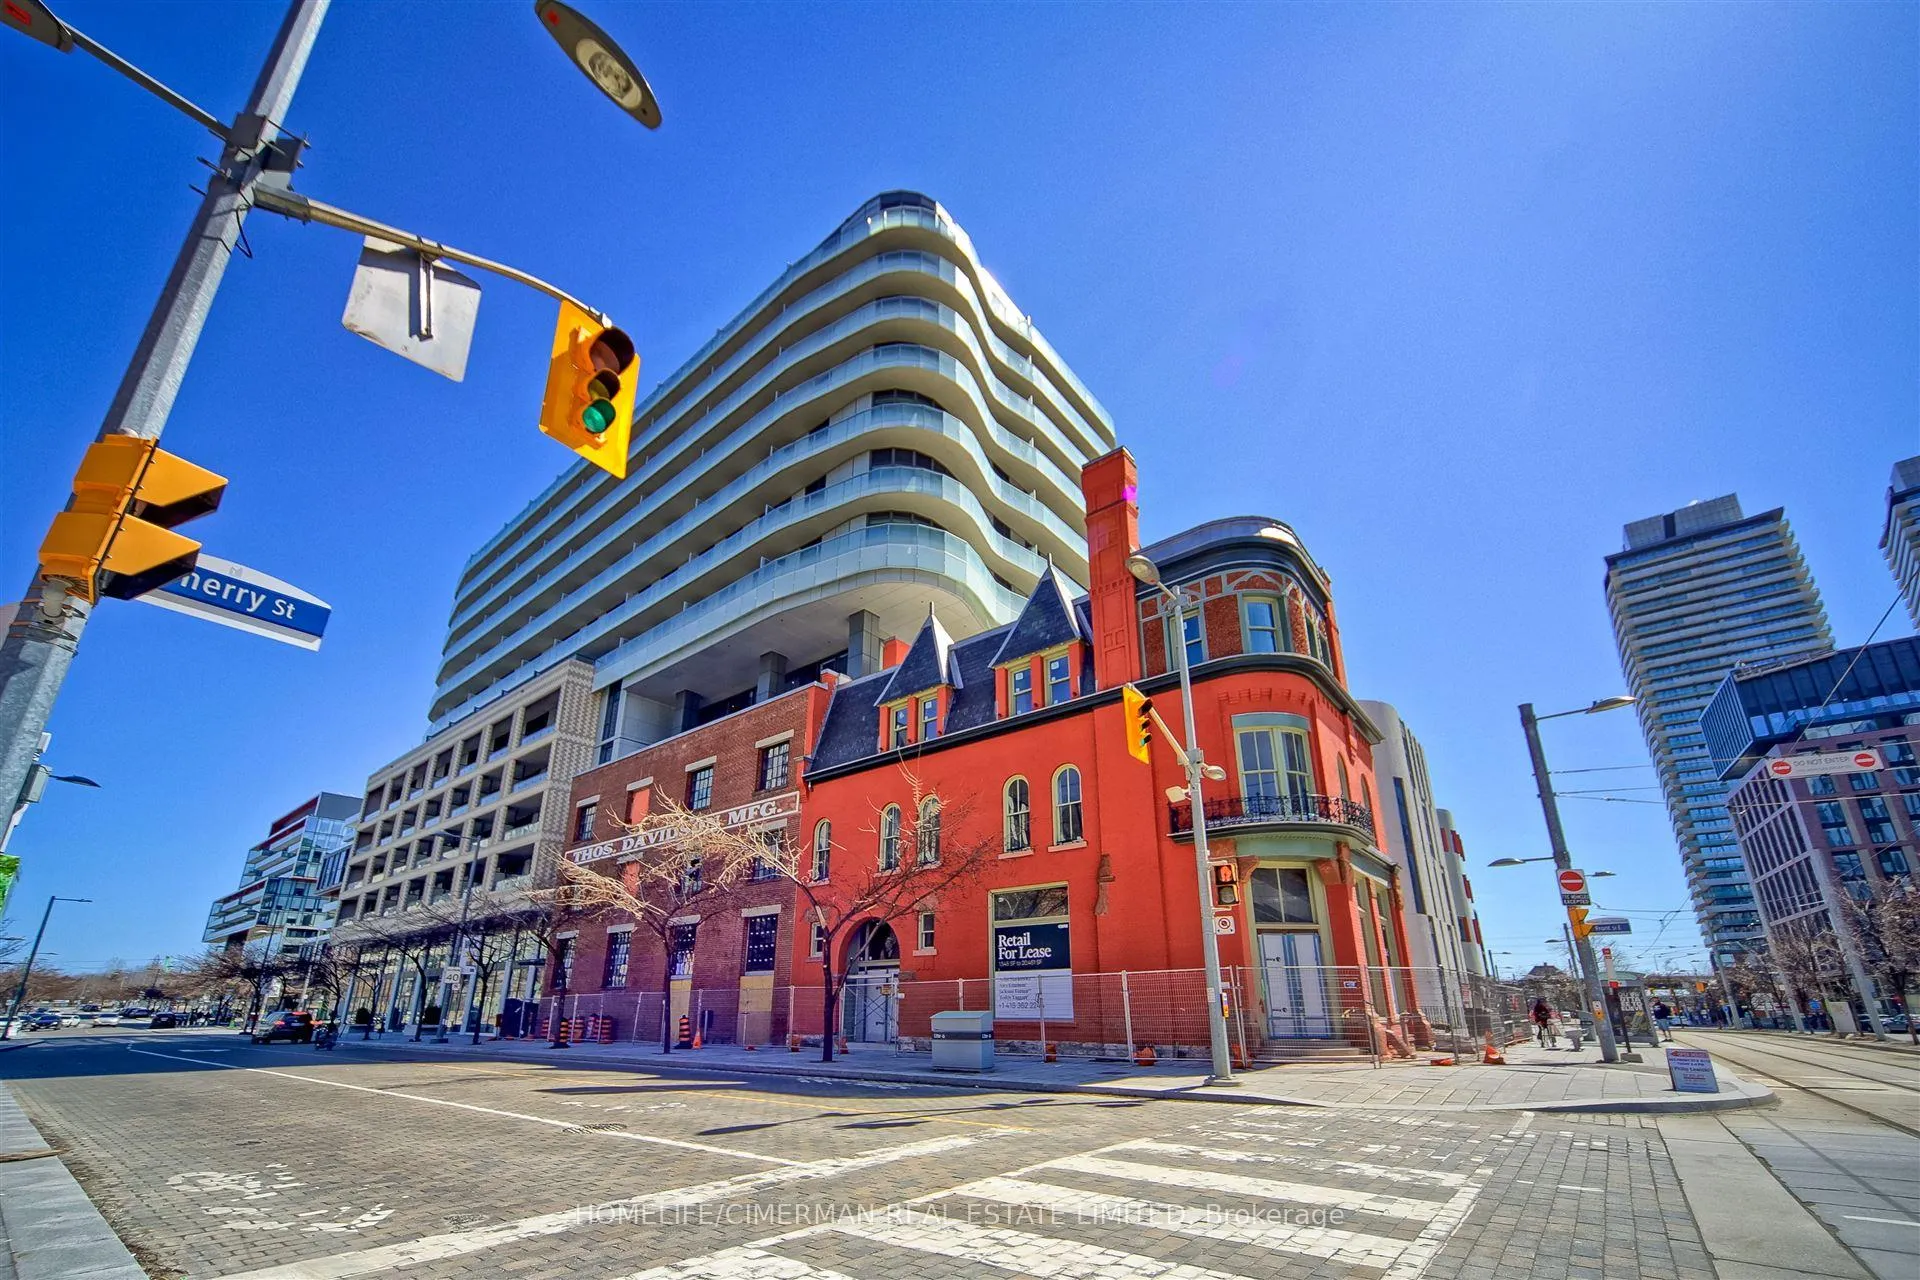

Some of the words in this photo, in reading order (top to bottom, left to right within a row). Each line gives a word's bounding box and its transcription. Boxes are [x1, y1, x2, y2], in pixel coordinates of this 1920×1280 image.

[180, 571, 267, 613] herry
[271, 599, 296, 620] St
[572, 844, 617, 863] THOS.
[727, 800, 783, 826] MFG.
[997, 932, 1031, 947] Retail
[998, 947, 1018, 960] For
[1019, 946, 1052, 959] Lease
